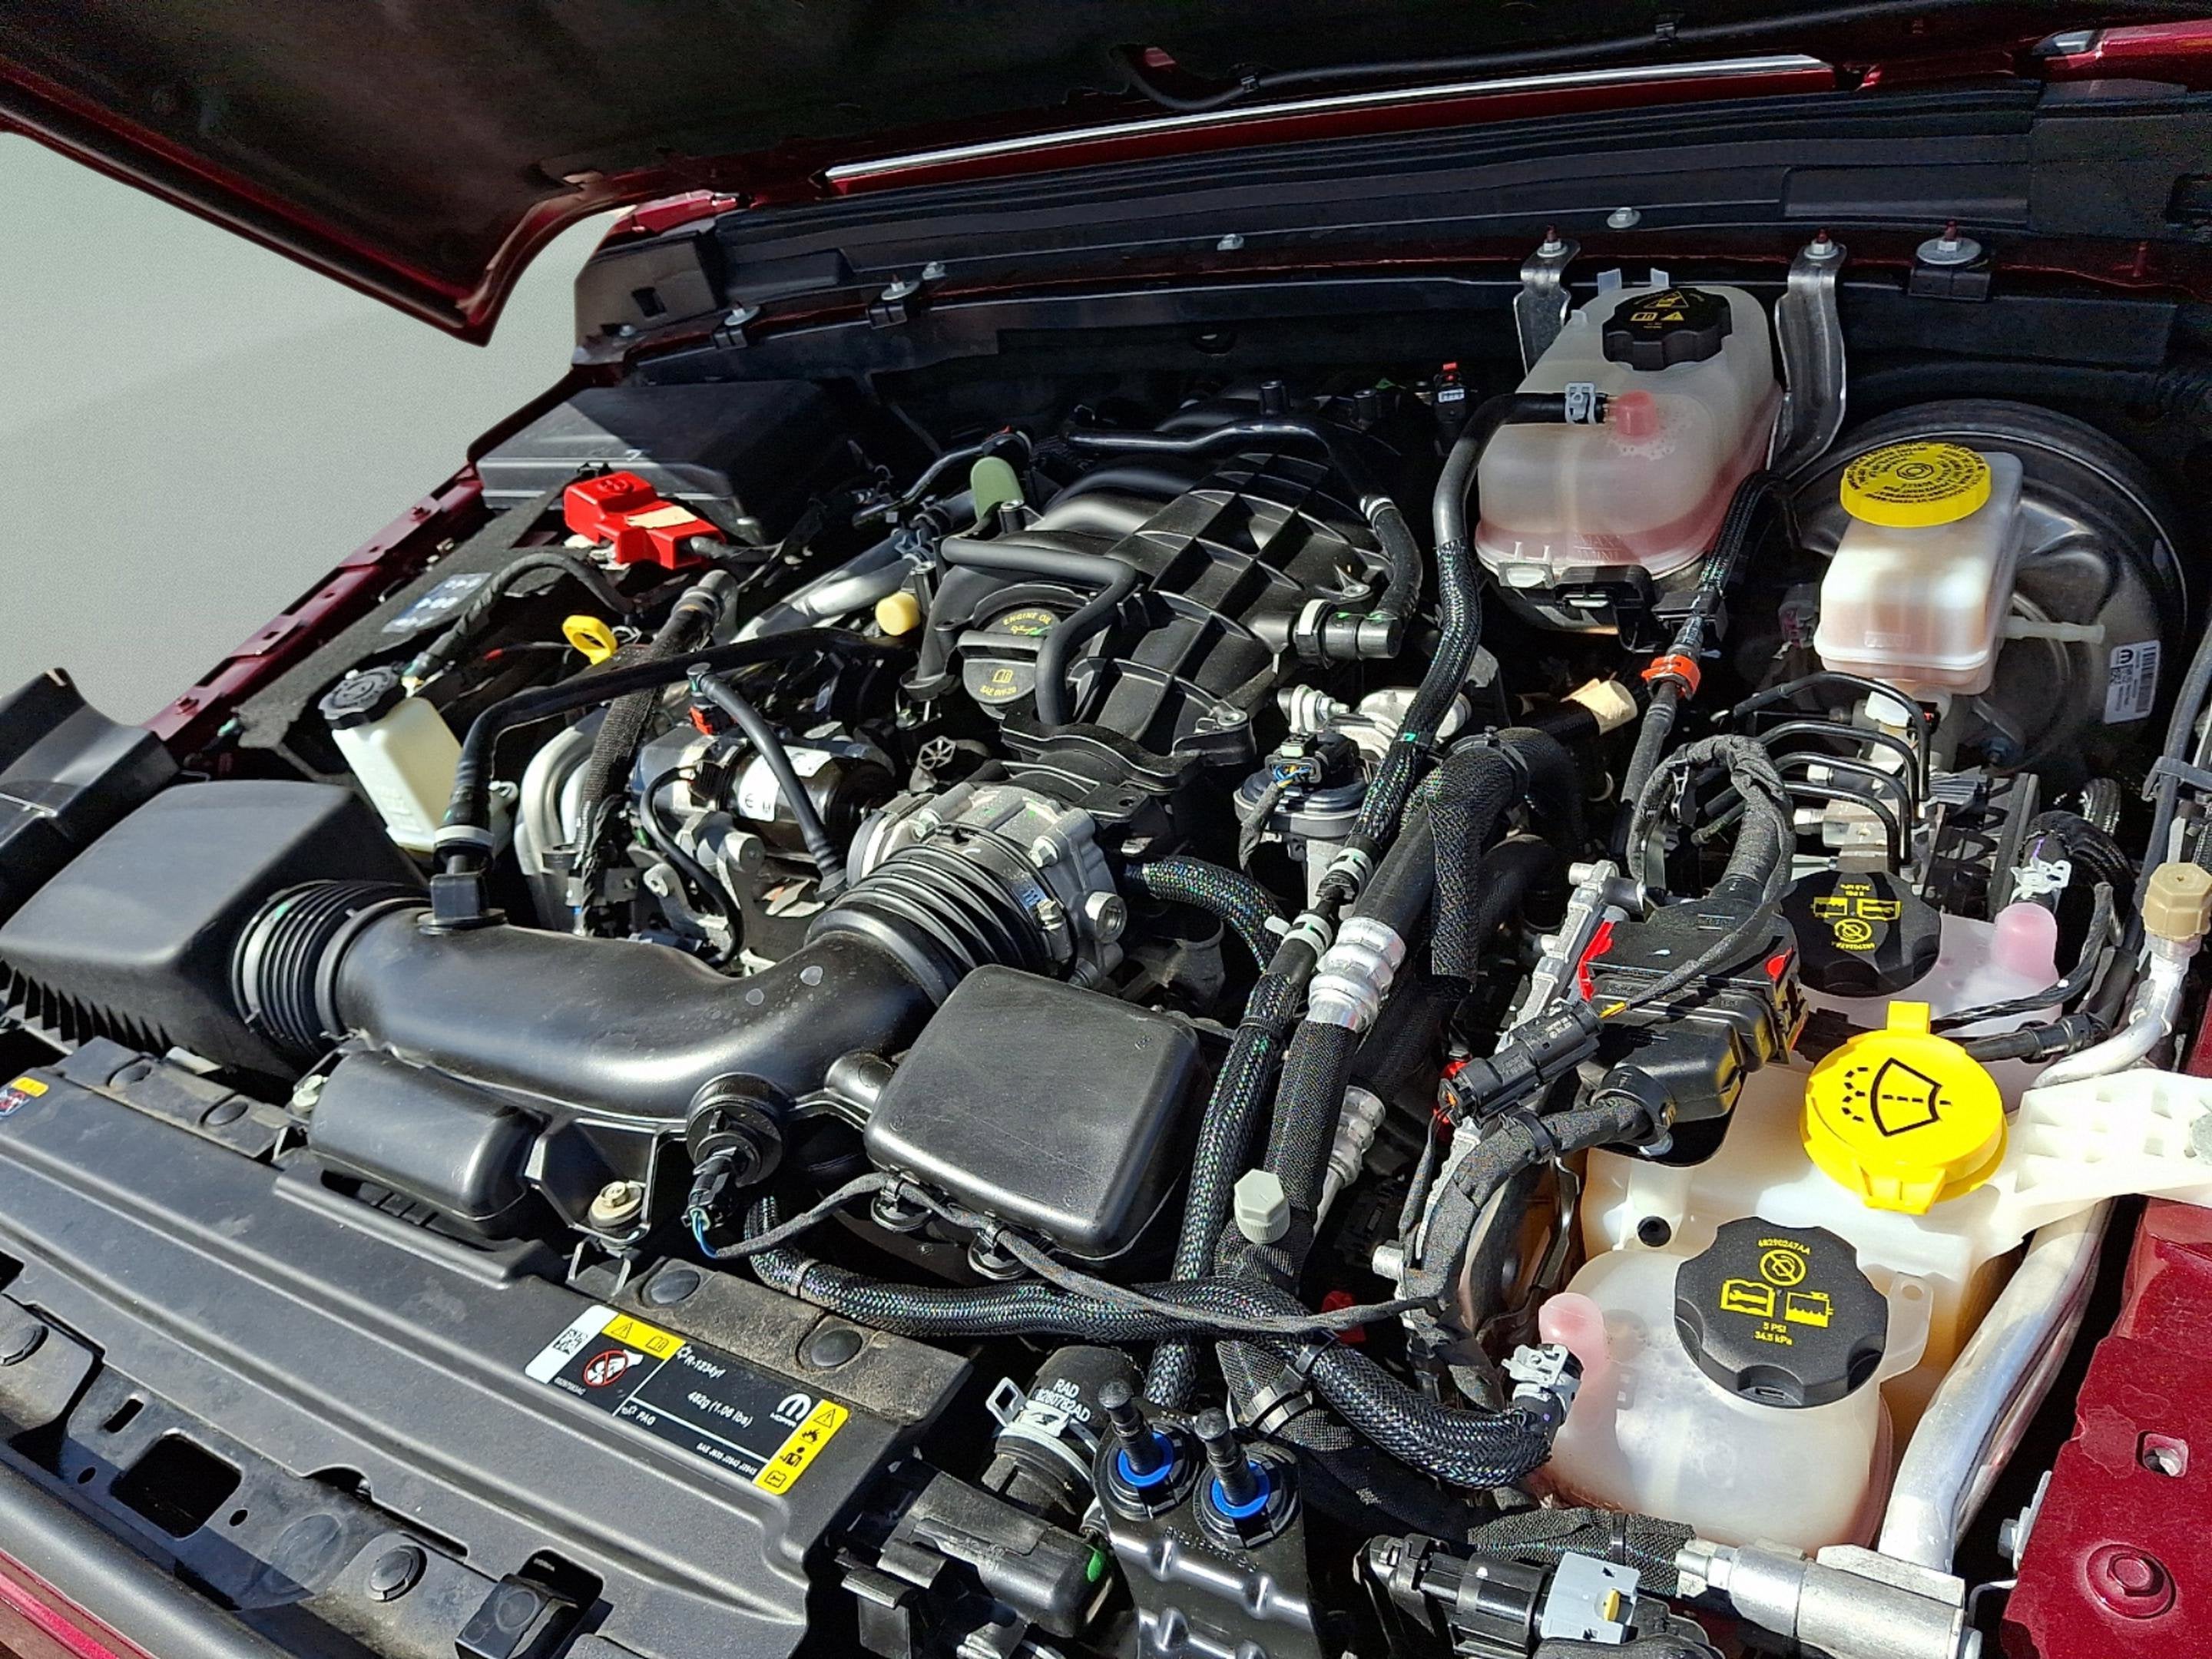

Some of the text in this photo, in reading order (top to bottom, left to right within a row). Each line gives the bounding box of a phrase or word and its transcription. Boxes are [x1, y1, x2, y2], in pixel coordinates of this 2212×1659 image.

[1003, 612, 1051, 625] ENGINE OIL
[1770, 1322, 1786, 1333] PSI
[1774, 1334, 1792, 1346] kPa
[684, 1356, 726, 1379] R-1234yf
[1053, 1378, 1080, 1398] RAD
[732, 1411, 753, 1429] lbs)
